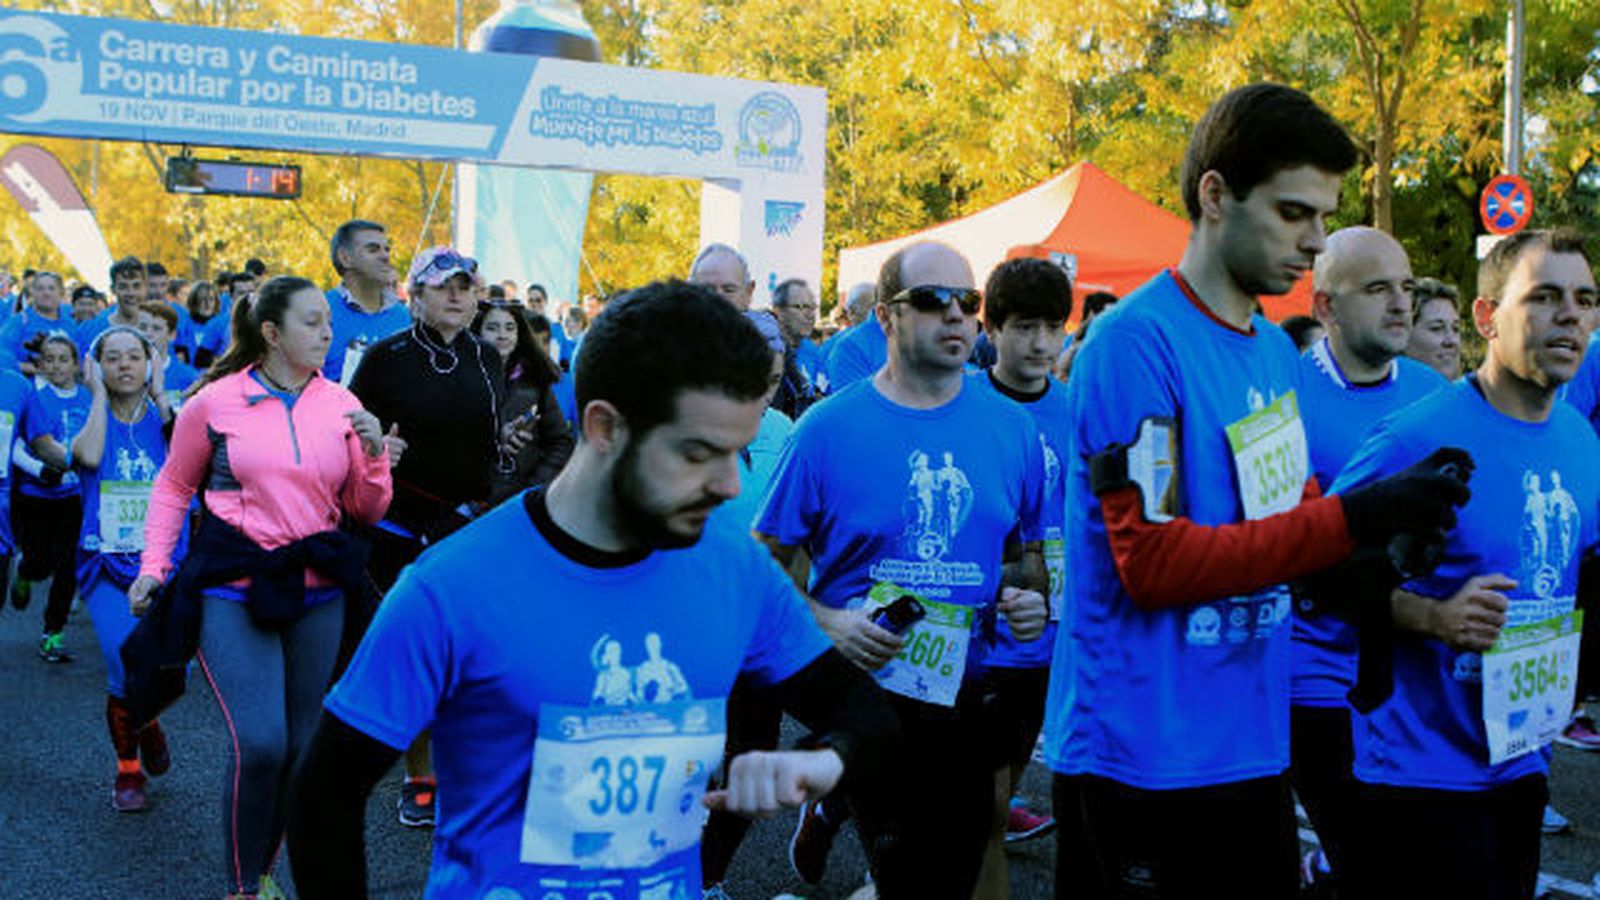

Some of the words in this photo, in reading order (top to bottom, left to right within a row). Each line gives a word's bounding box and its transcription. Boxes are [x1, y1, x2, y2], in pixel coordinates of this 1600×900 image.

[99, 29, 230, 69] Carrera
[239, 48, 257, 76] y
[266, 45, 418, 84] Caminata
[99, 60, 233, 98] Popular
[239, 79, 298, 105] por
[303, 77, 332, 106] la
[341, 80, 478, 118] Diabetes
[100, 102, 119, 118] 19
[125, 102, 168, 122] NOV
[182, 105, 248, 129] Parque
[347, 118, 407, 138] Madrid
[1508, 654, 1557, 701] 3564
[588, 755, 667, 816] 387
